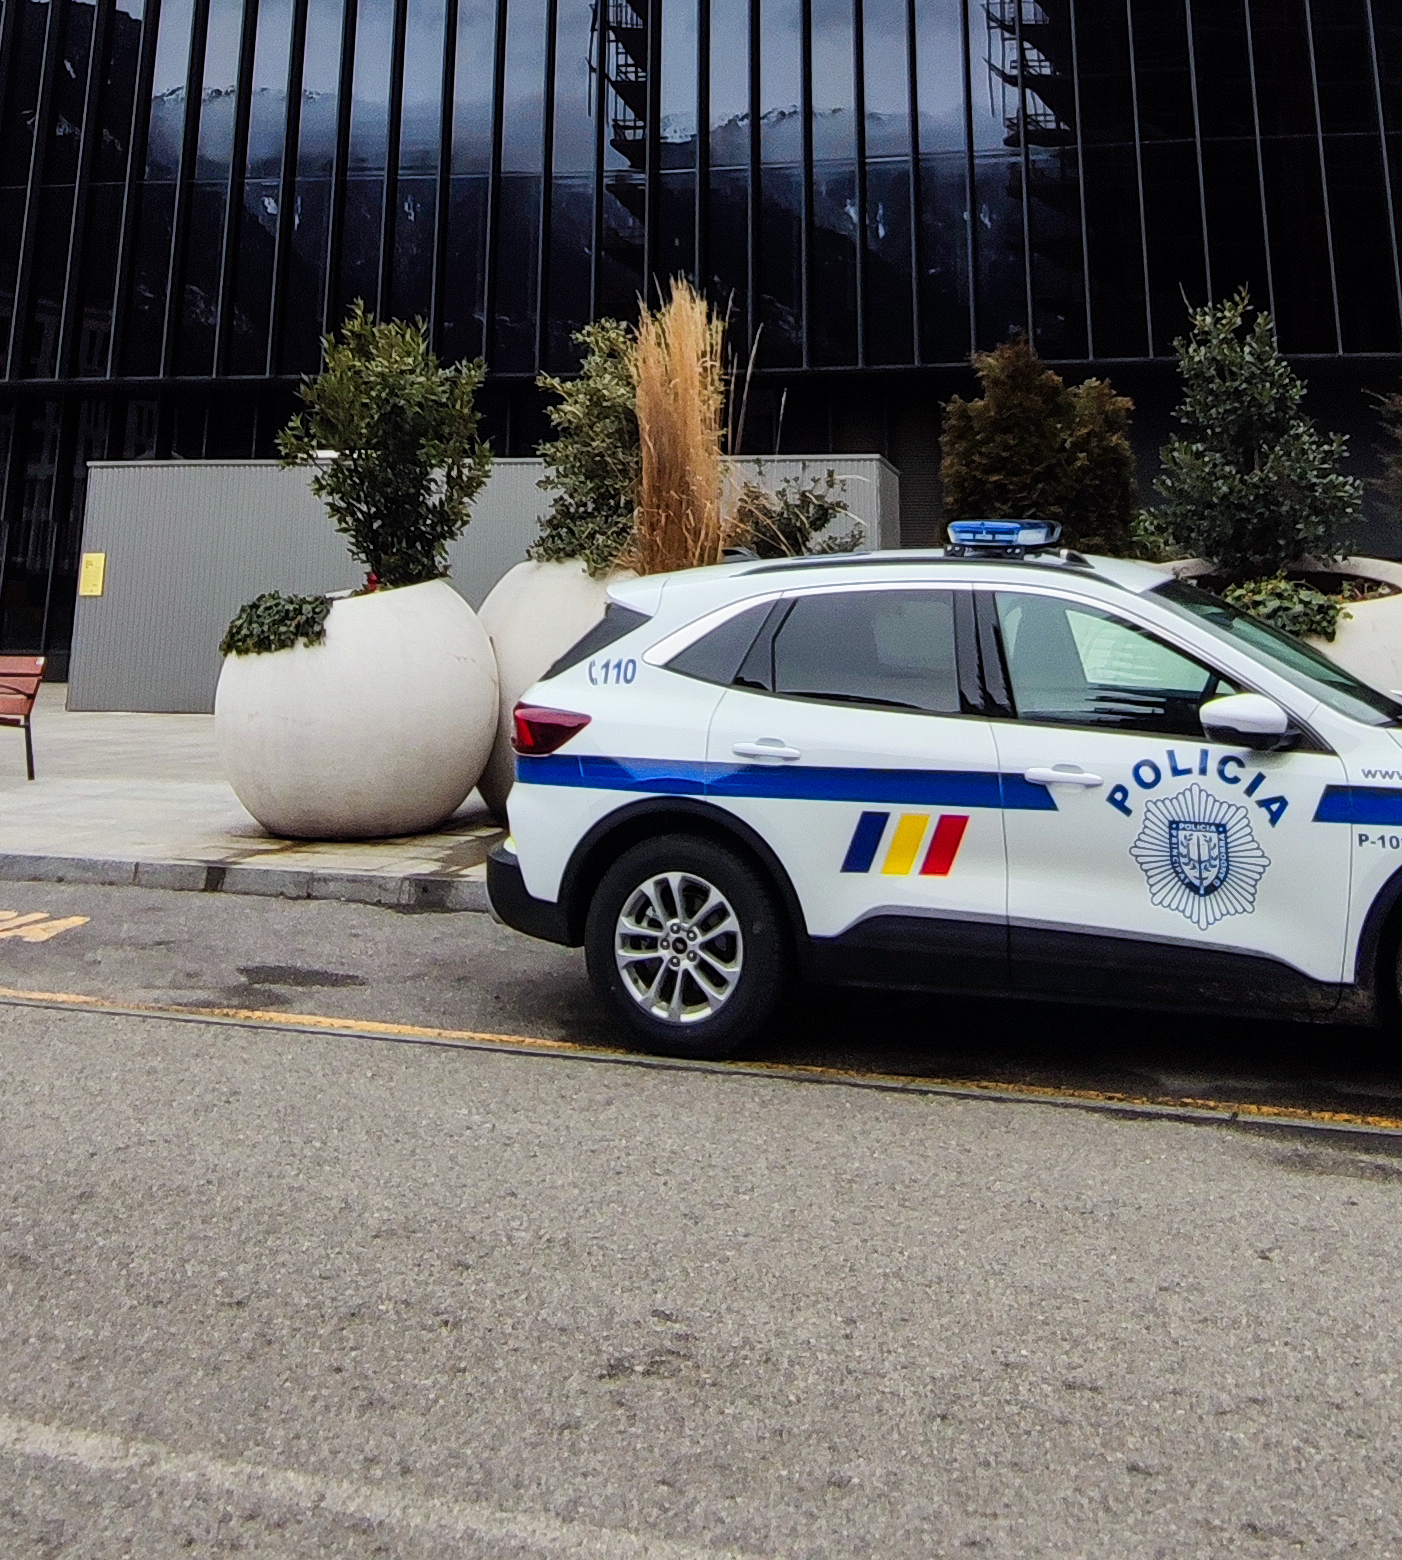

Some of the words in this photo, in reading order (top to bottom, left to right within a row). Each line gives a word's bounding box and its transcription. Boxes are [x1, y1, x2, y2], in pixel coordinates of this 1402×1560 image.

[600, 658, 637, 685] 110
[1105, 747, 1289, 829] POLICIA
[1178, 822, 1217, 833] POLICIA
